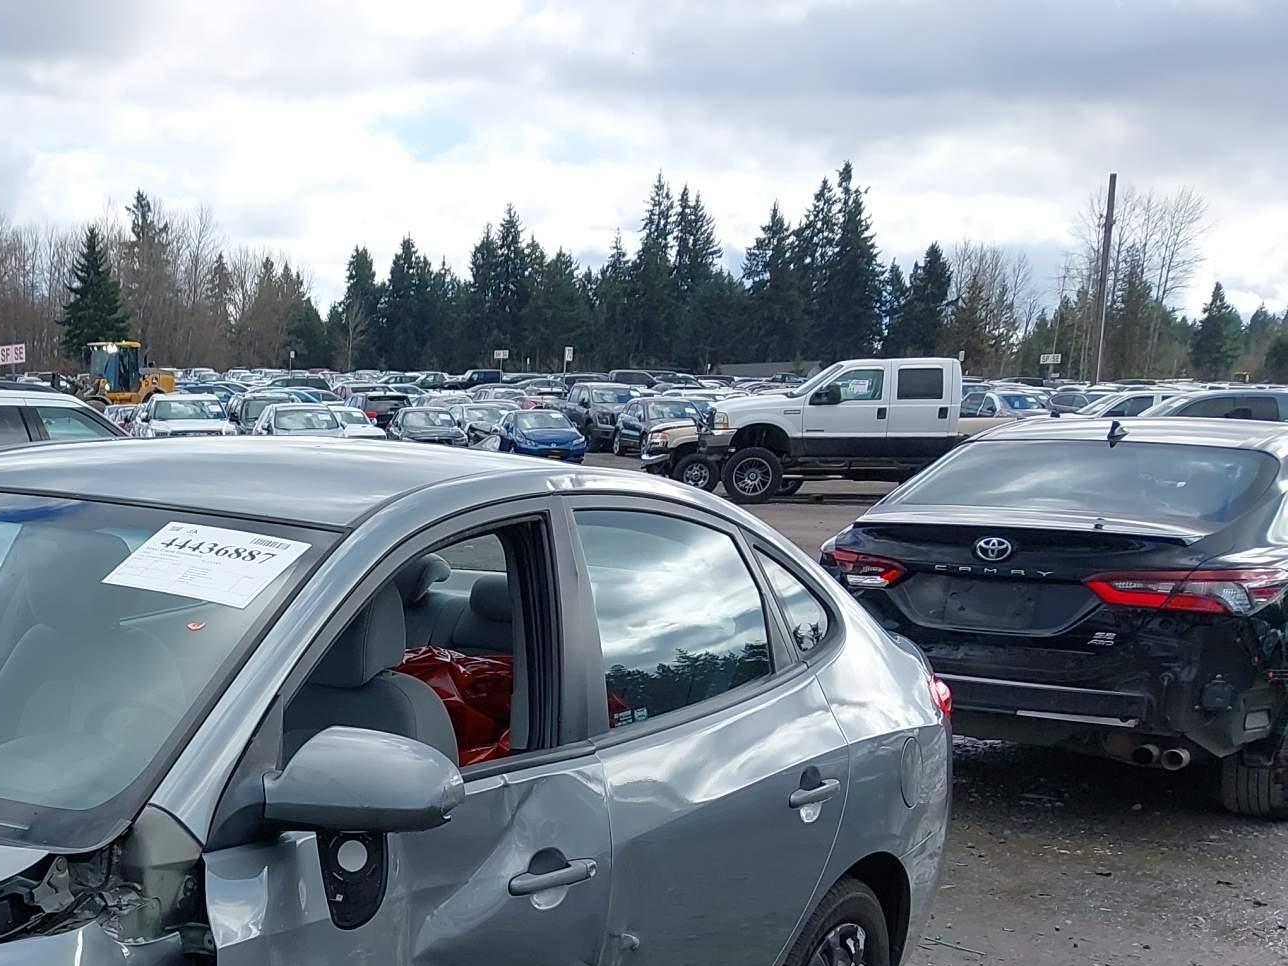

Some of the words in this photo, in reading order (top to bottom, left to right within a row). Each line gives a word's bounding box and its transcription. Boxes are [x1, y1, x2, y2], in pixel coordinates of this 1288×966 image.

[0, 347, 10, 362] SF
[14, 346, 24, 360] SE
[160, 536, 277, 565] 44436887
[934, 564, 1055, 577] CAMRY
